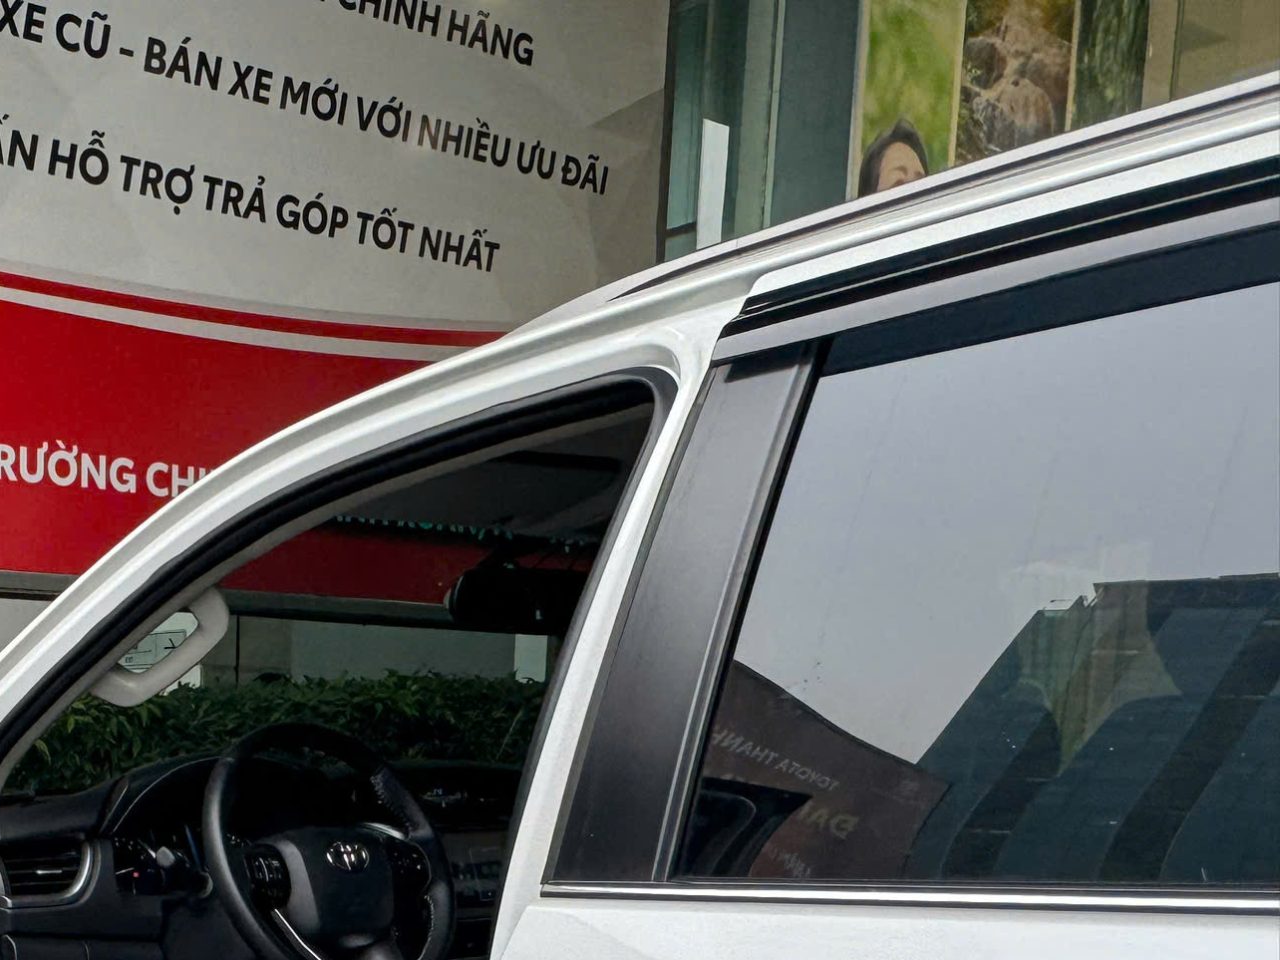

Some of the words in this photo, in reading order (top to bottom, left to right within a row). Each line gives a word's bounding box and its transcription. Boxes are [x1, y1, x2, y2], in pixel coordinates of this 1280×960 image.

[55, 11, 111, 59] CŨ
[143, 36, 223, 91] BÁN
[228, 61, 273, 105] XE
[279, 76, 348, 127] MỚI
[356, 96, 412, 142] VỚI
[417, 114, 511, 168] NHIỀU
[517, 140, 557, 180] ƯU
[561, 154, 609, 196] ĐÃI
[446, 9, 535, 66] HÃNG
[47, 130, 110, 186] HỖ
[119, 155, 196, 216] TRỢ
[203, 175, 267, 224] TRẢ
[276, 192, 349, 239] GÓP
[357, 207, 415, 254] TỐT
[418, 226, 501, 273] NHẤT
